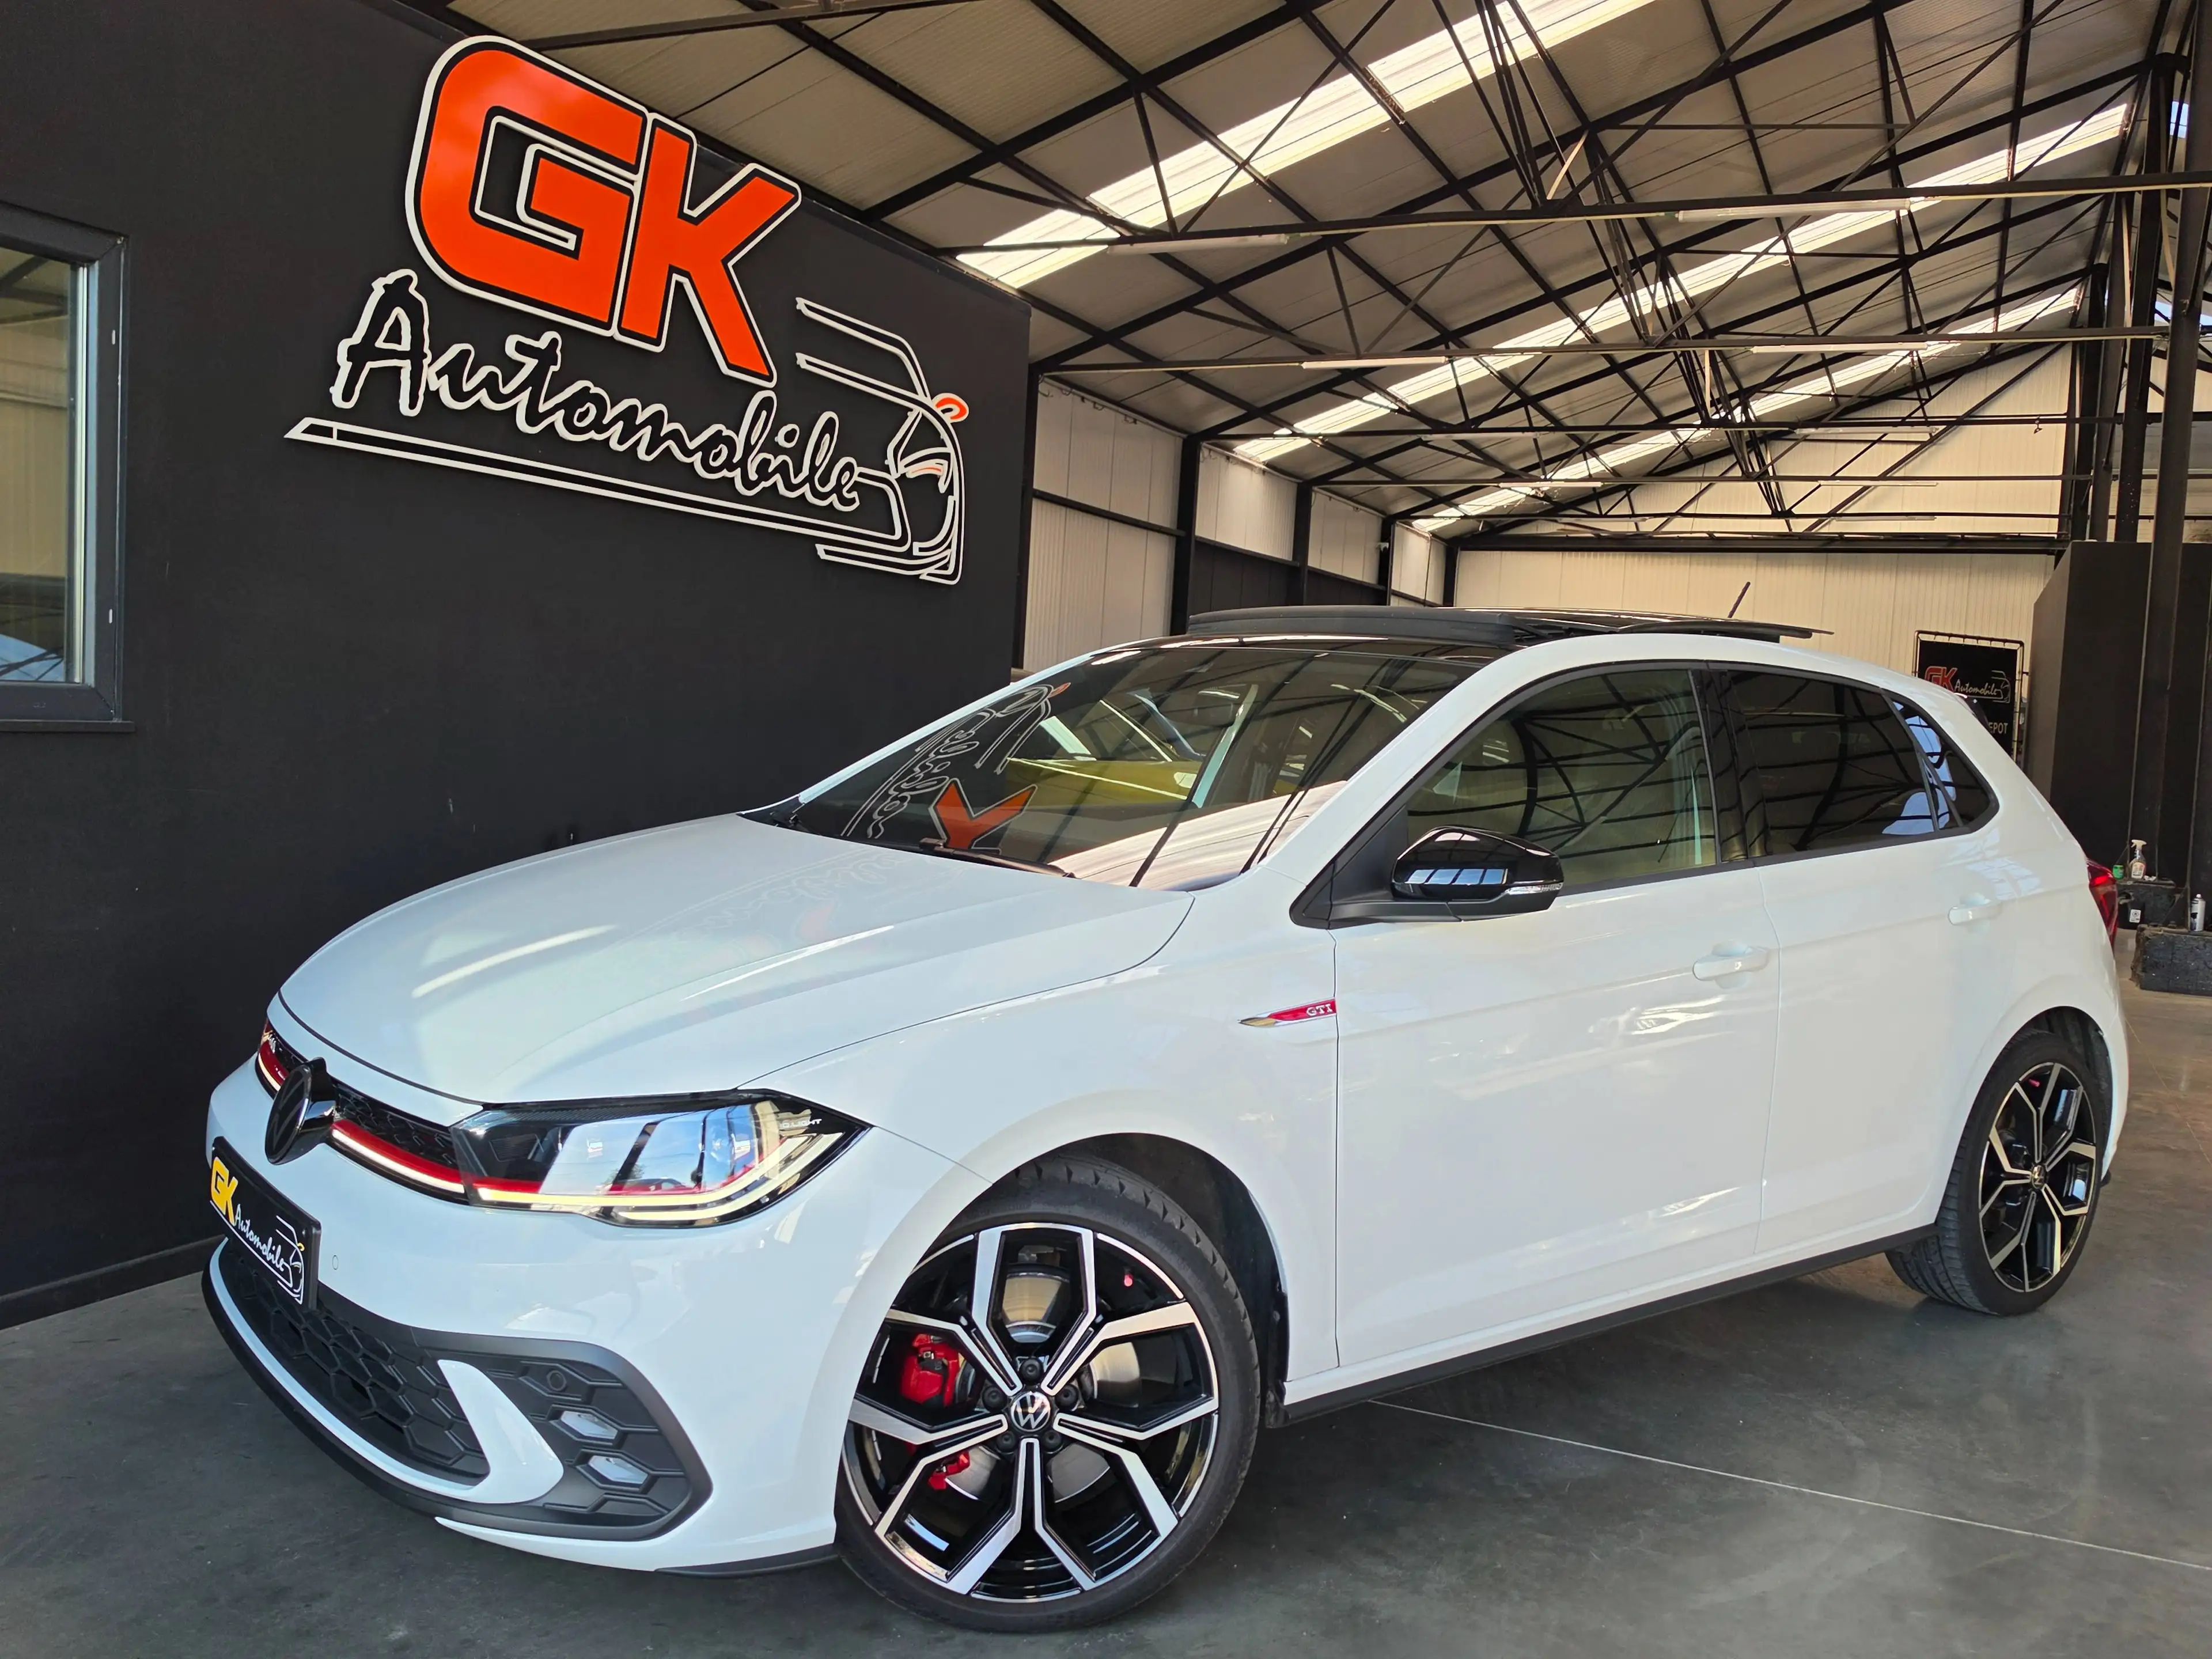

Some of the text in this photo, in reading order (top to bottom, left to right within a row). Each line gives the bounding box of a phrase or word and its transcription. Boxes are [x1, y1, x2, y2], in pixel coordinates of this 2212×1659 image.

[406, 35, 801, 387] GK
[331, 268, 860, 512] Automobile
[1955, 679, 1997, 695] Automobile
[1988, 722, 2008, 733] EPOT
[1306, 1003, 1332, 1016] GTI
[211, 1157, 284, 1272] GK Automobile
[1016, 1392, 1049, 1429] VW
